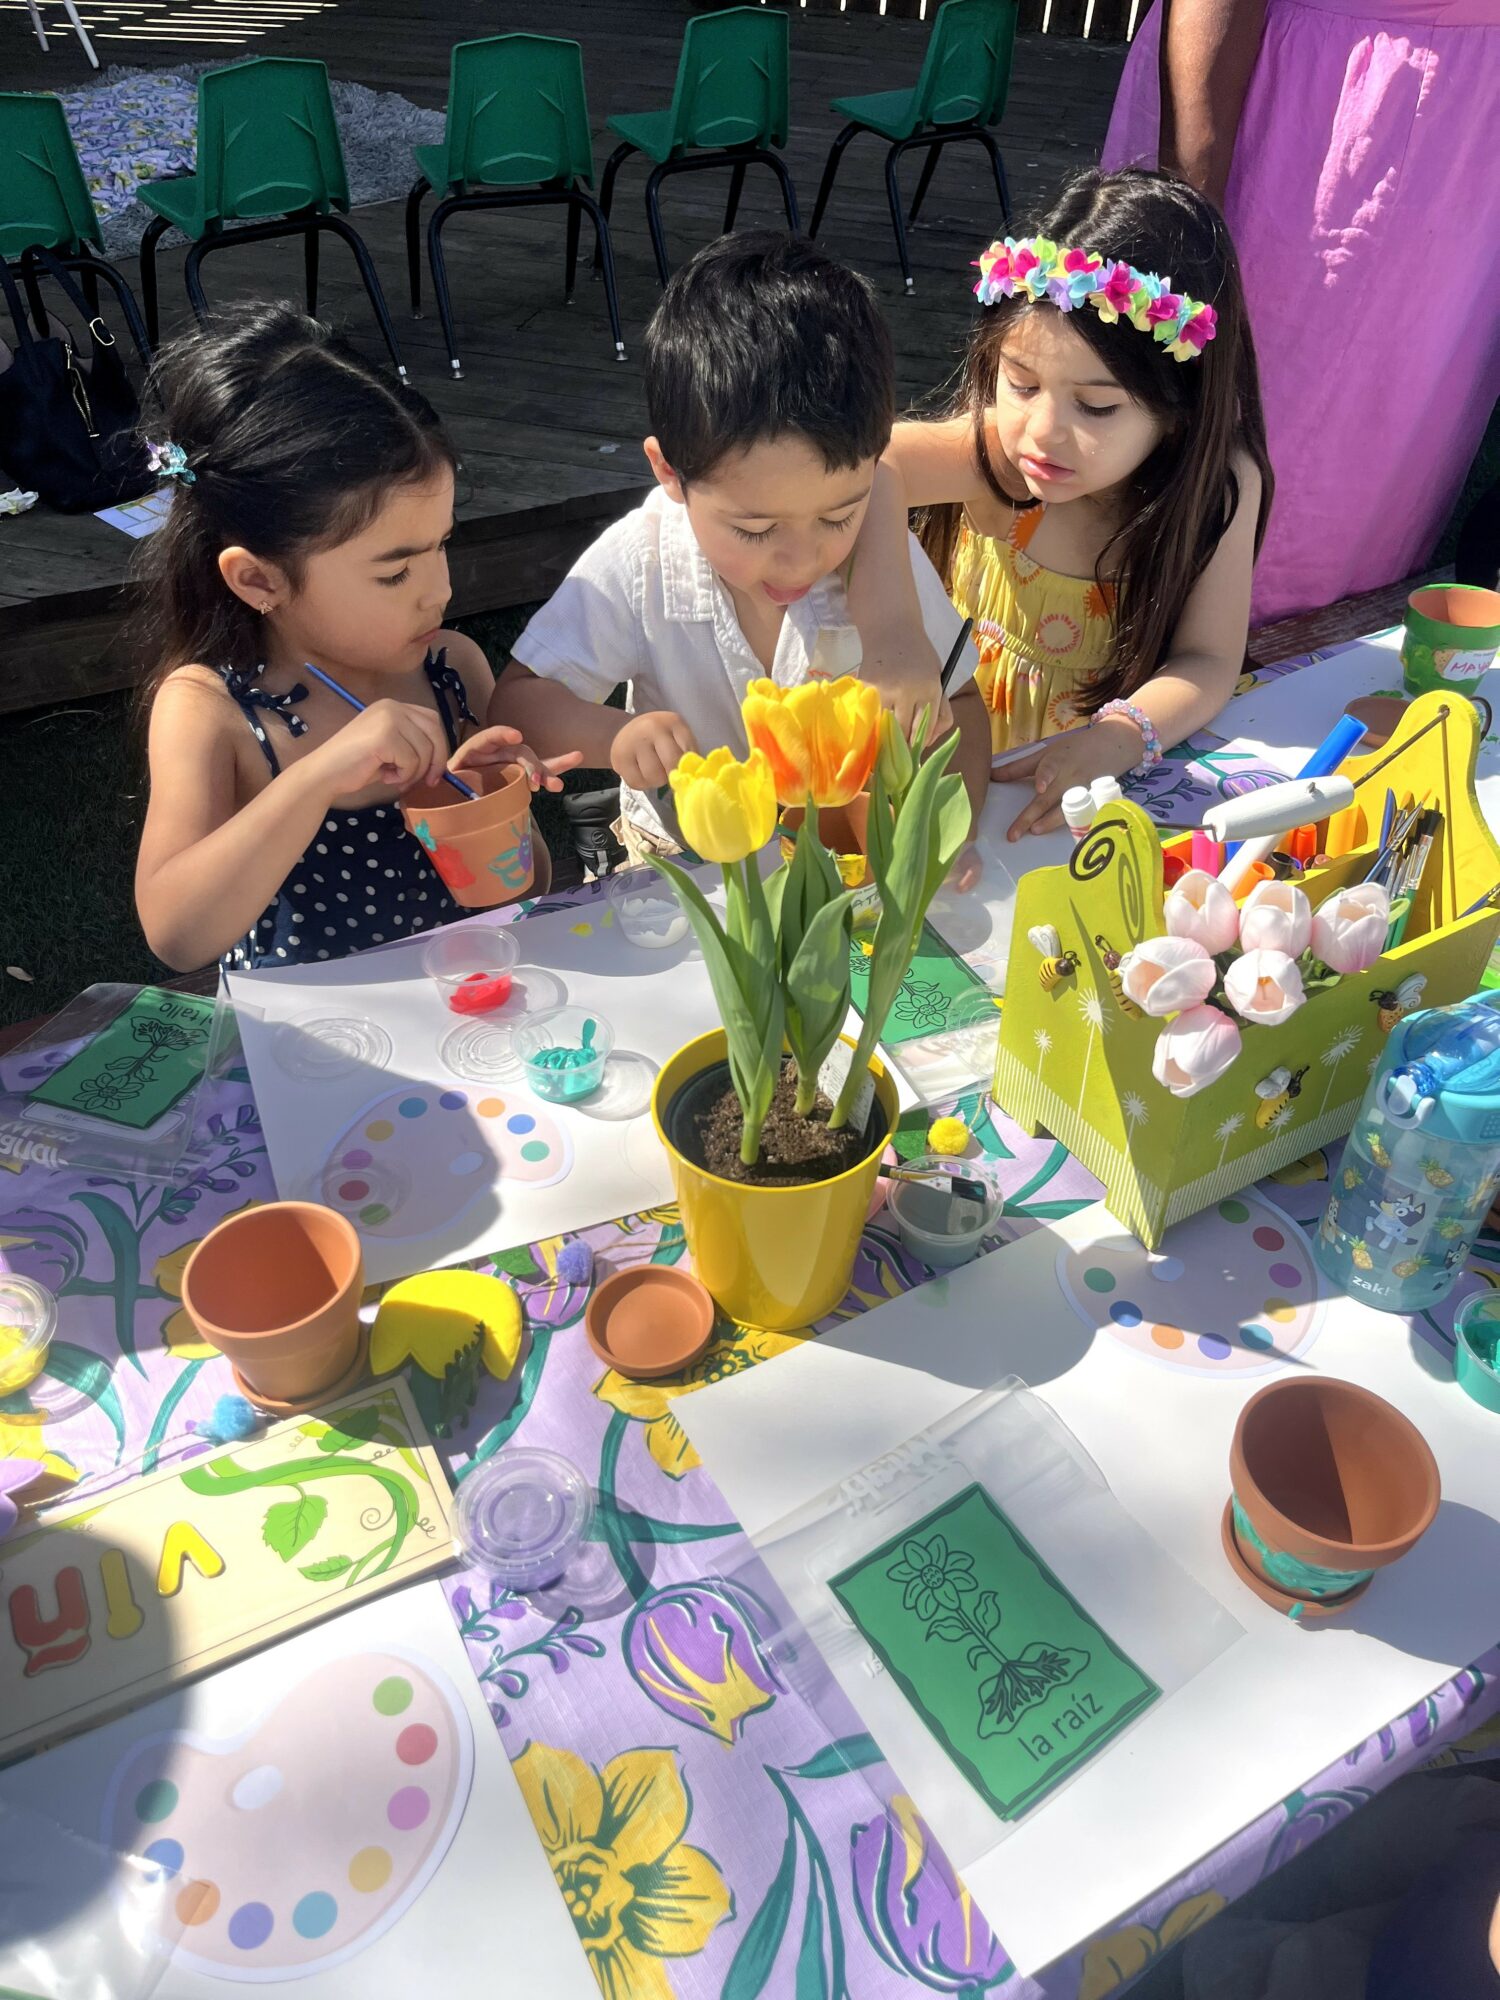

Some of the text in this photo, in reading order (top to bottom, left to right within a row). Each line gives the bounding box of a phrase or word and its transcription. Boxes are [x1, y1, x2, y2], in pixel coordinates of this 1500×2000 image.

[159, 1003, 200, 1021] tallo
[1352, 1275, 1390, 1296] zak!
[1017, 1692, 1104, 1762] la raíz
